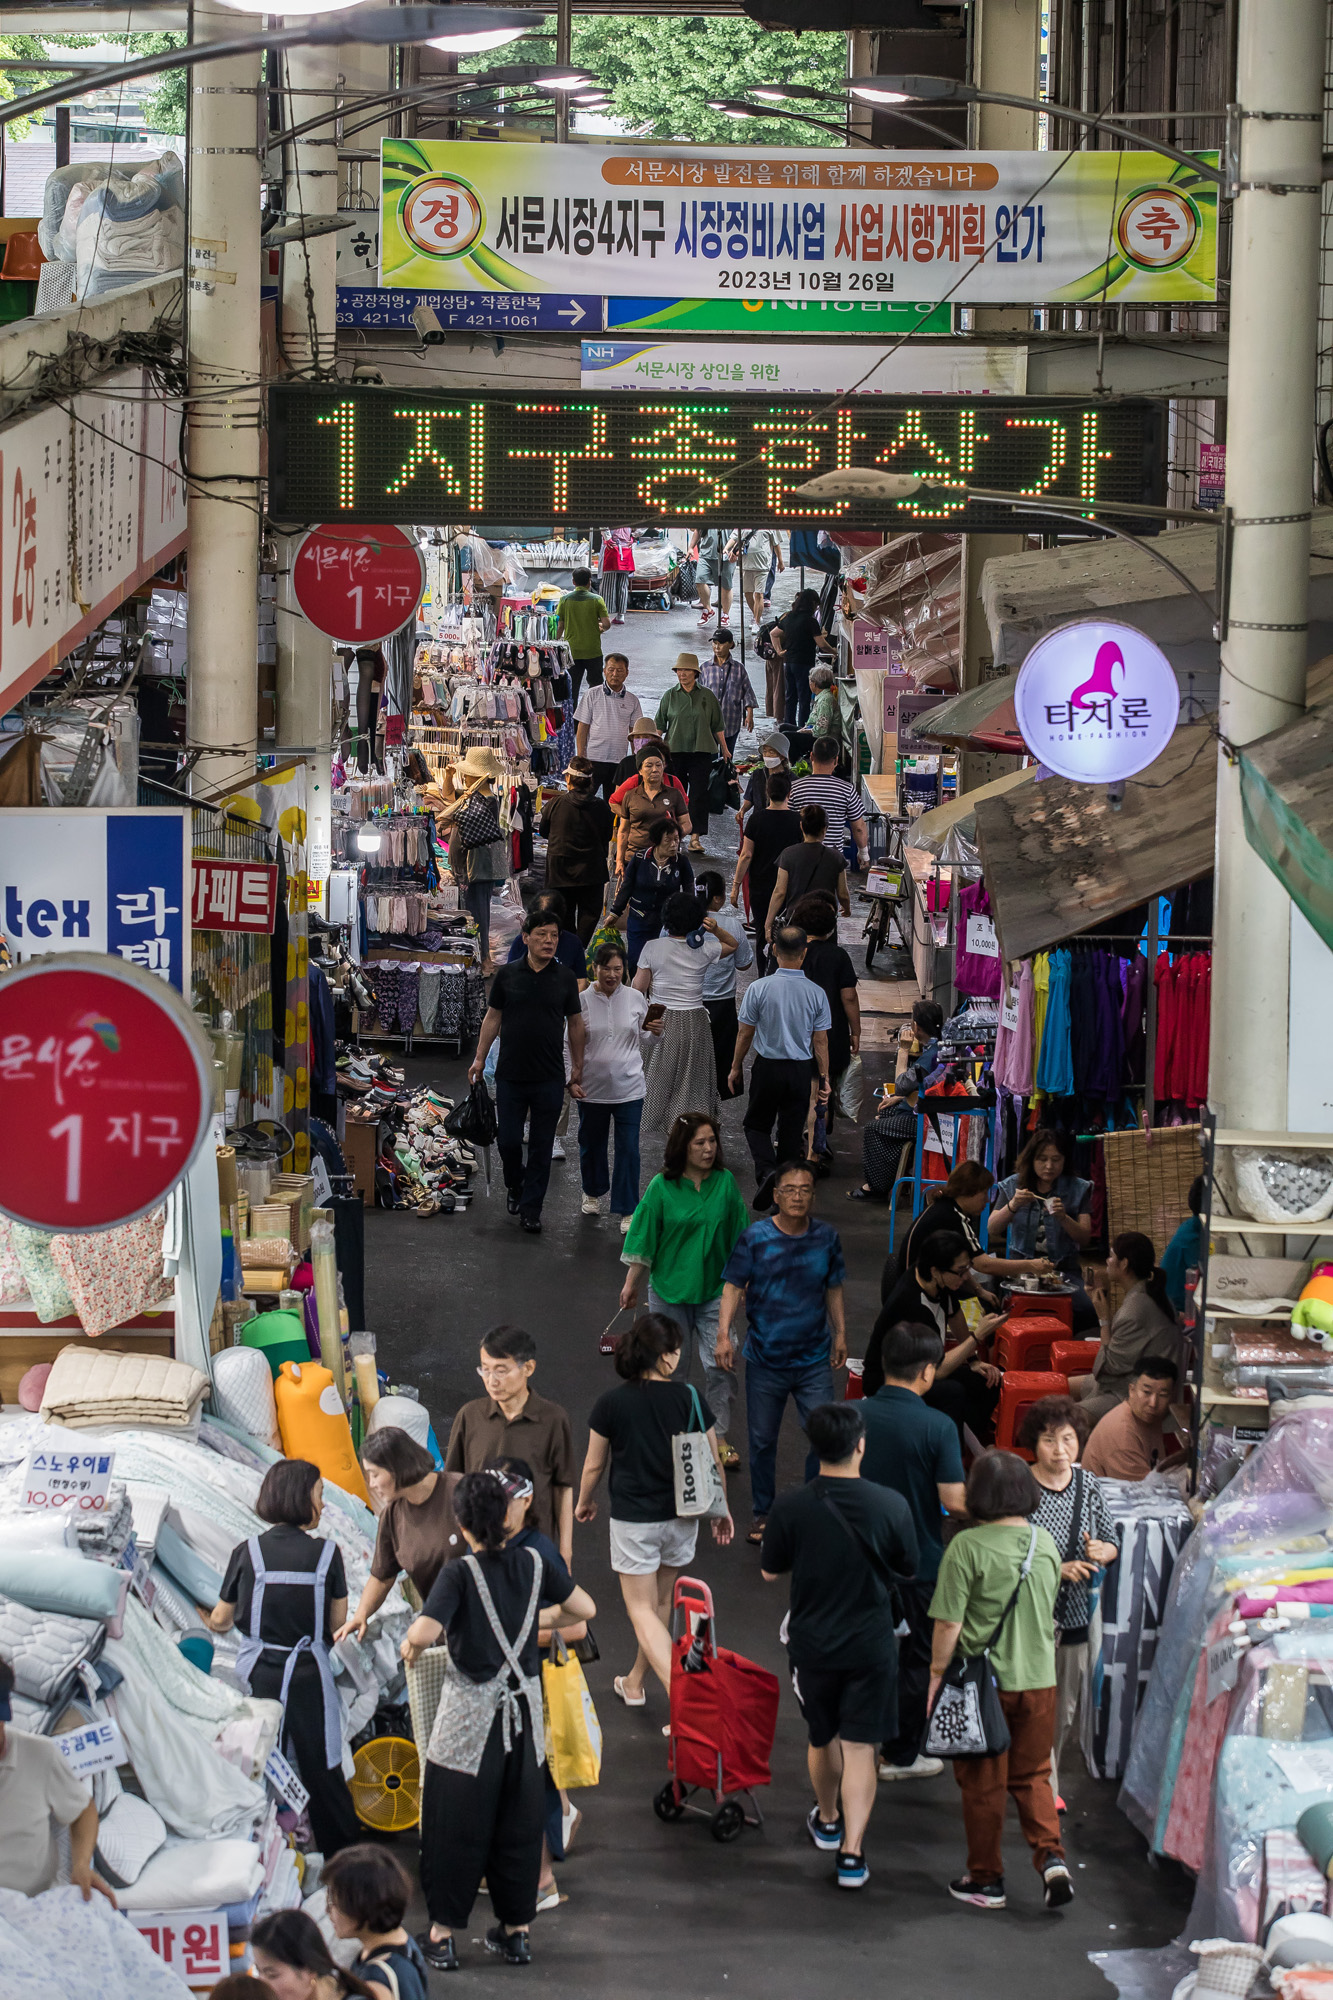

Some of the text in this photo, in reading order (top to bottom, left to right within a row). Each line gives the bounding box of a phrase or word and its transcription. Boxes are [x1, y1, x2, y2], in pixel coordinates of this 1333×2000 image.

[624, 160, 977, 189] 서문시장 발전을 위해 함께 하겠습니다
[418, 193, 460, 240] 경
[495, 195, 1046, 264] 서문시장4지구 시장정비사업 사업시행계획 인가
[1135, 205, 1181, 251] 축
[718, 270, 894, 293] 2023년 10월 26일
[350, 294, 542, 311] 공장직영 개업상담 작품한복
[449, 314, 459, 325] F
[465, 315, 538, 326] 421-1061
[588, 346, 614, 358] NH
[634, 361, 781, 382] 서문시장 상인을 위한
[304, 544, 371, 582] 서문시장
[346, 583, 412, 630] 1 지구
[5, 885, 90, 938] tex
[48, 1111, 183, 1203] 1 지구
[32, 1454, 111, 1475] 스노우이불
[681, 1441, 697, 1504] Roots
